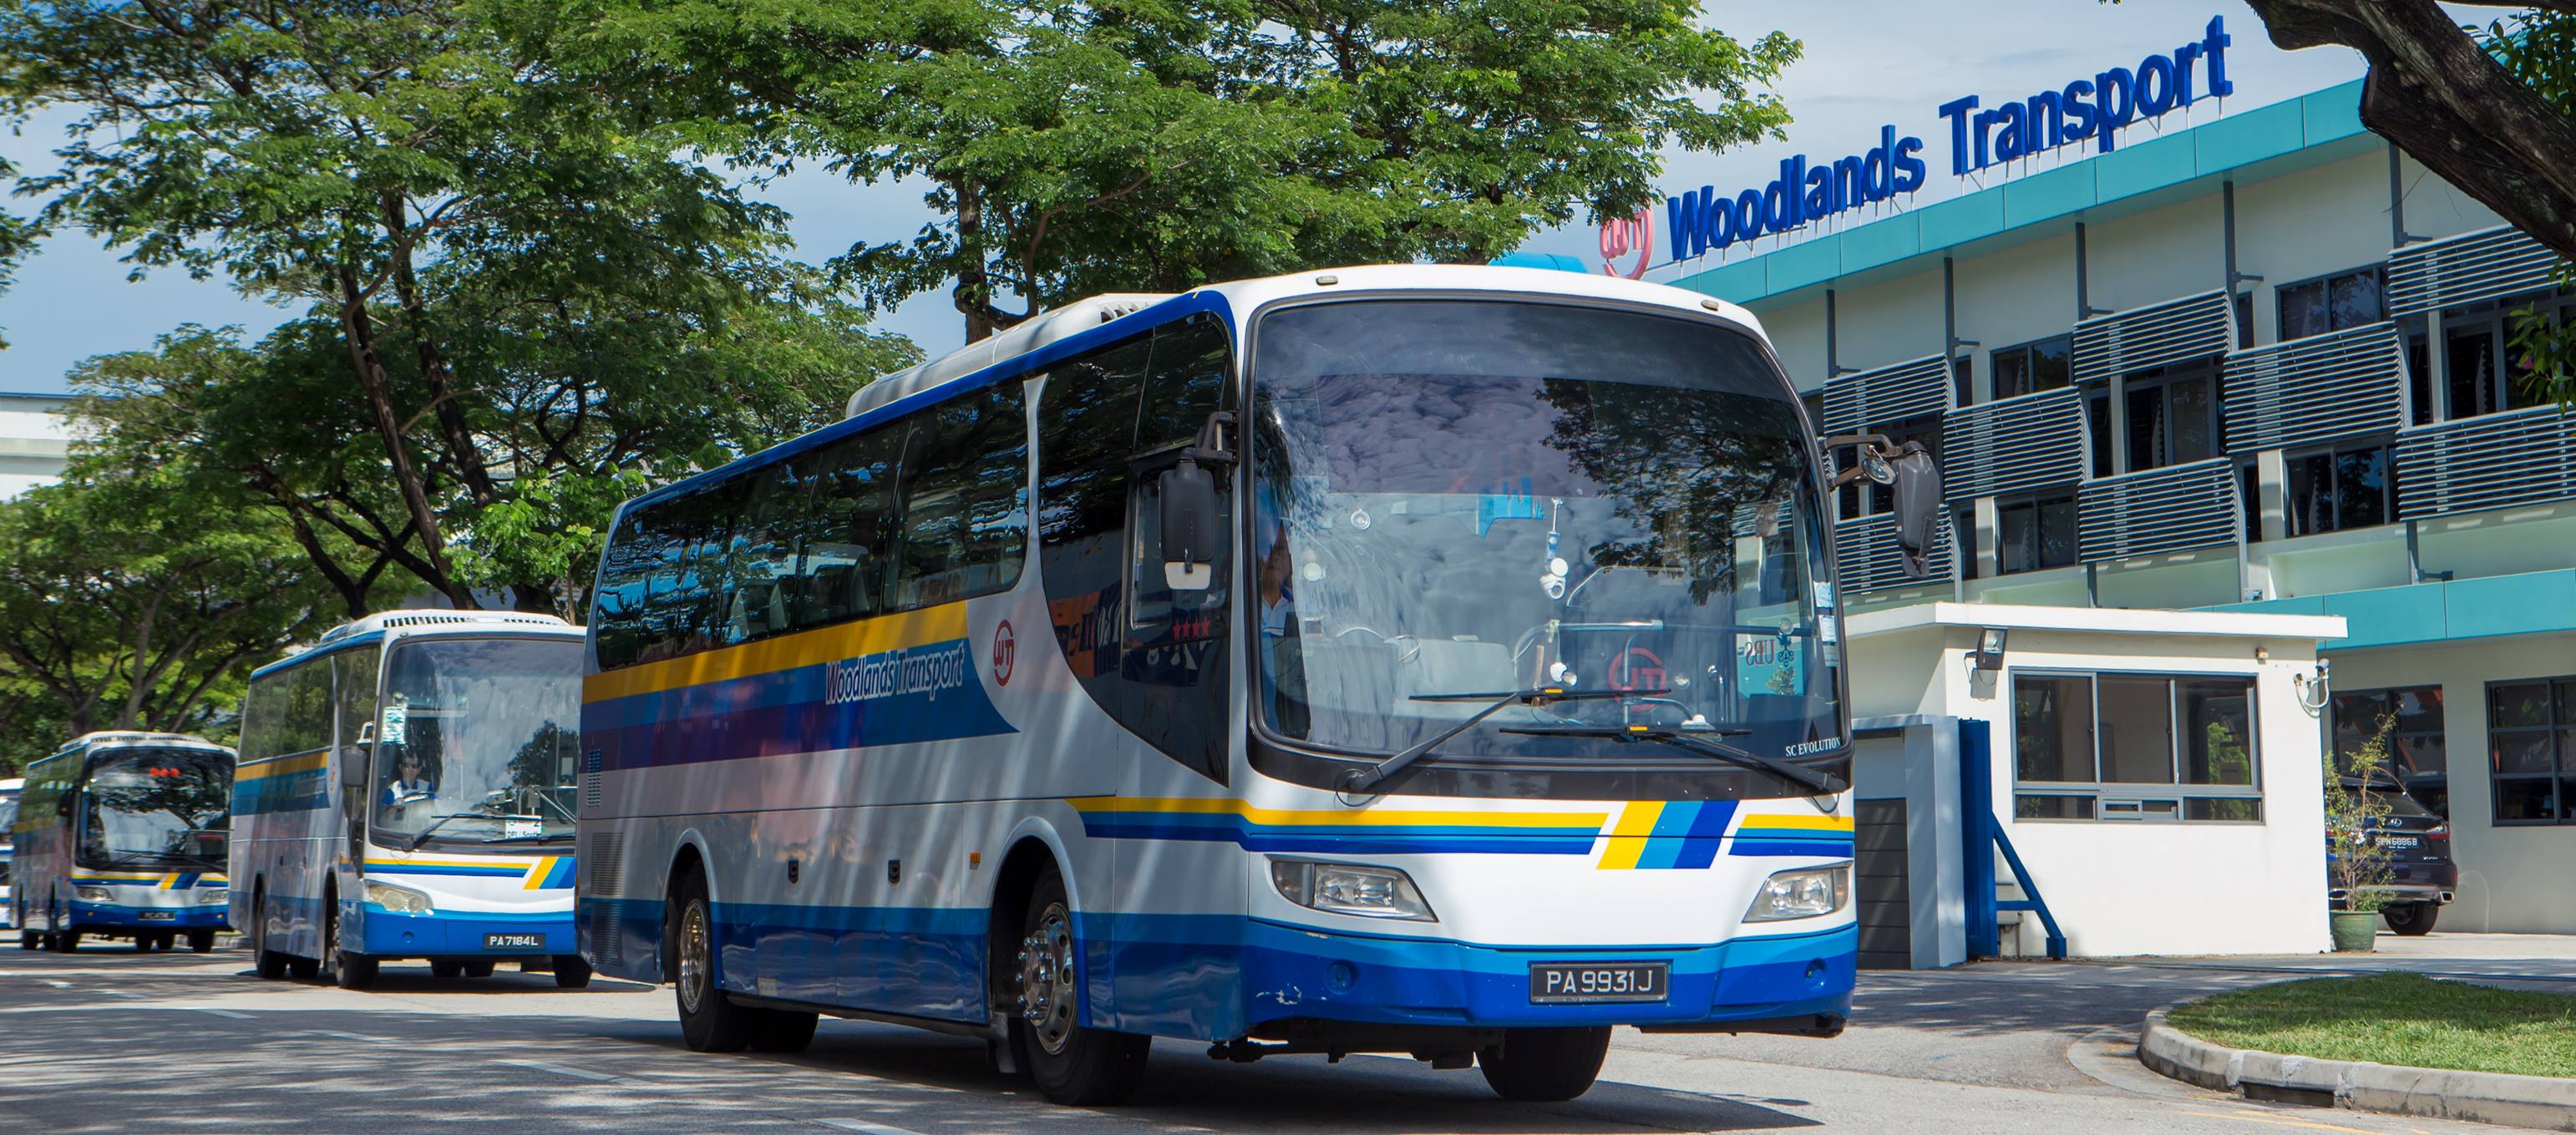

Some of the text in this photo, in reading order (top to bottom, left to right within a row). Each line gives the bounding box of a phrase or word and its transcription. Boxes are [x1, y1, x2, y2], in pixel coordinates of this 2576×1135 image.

[1667, 15, 2233, 261] Woodlands Transport
[825, 641, 966, 705] Woodlands Transport
[1785, 737, 1841, 757] SC EVOLUTION
[489, 935, 539, 946] PA7184L
[1546, 970, 1653, 994] PA9931J
